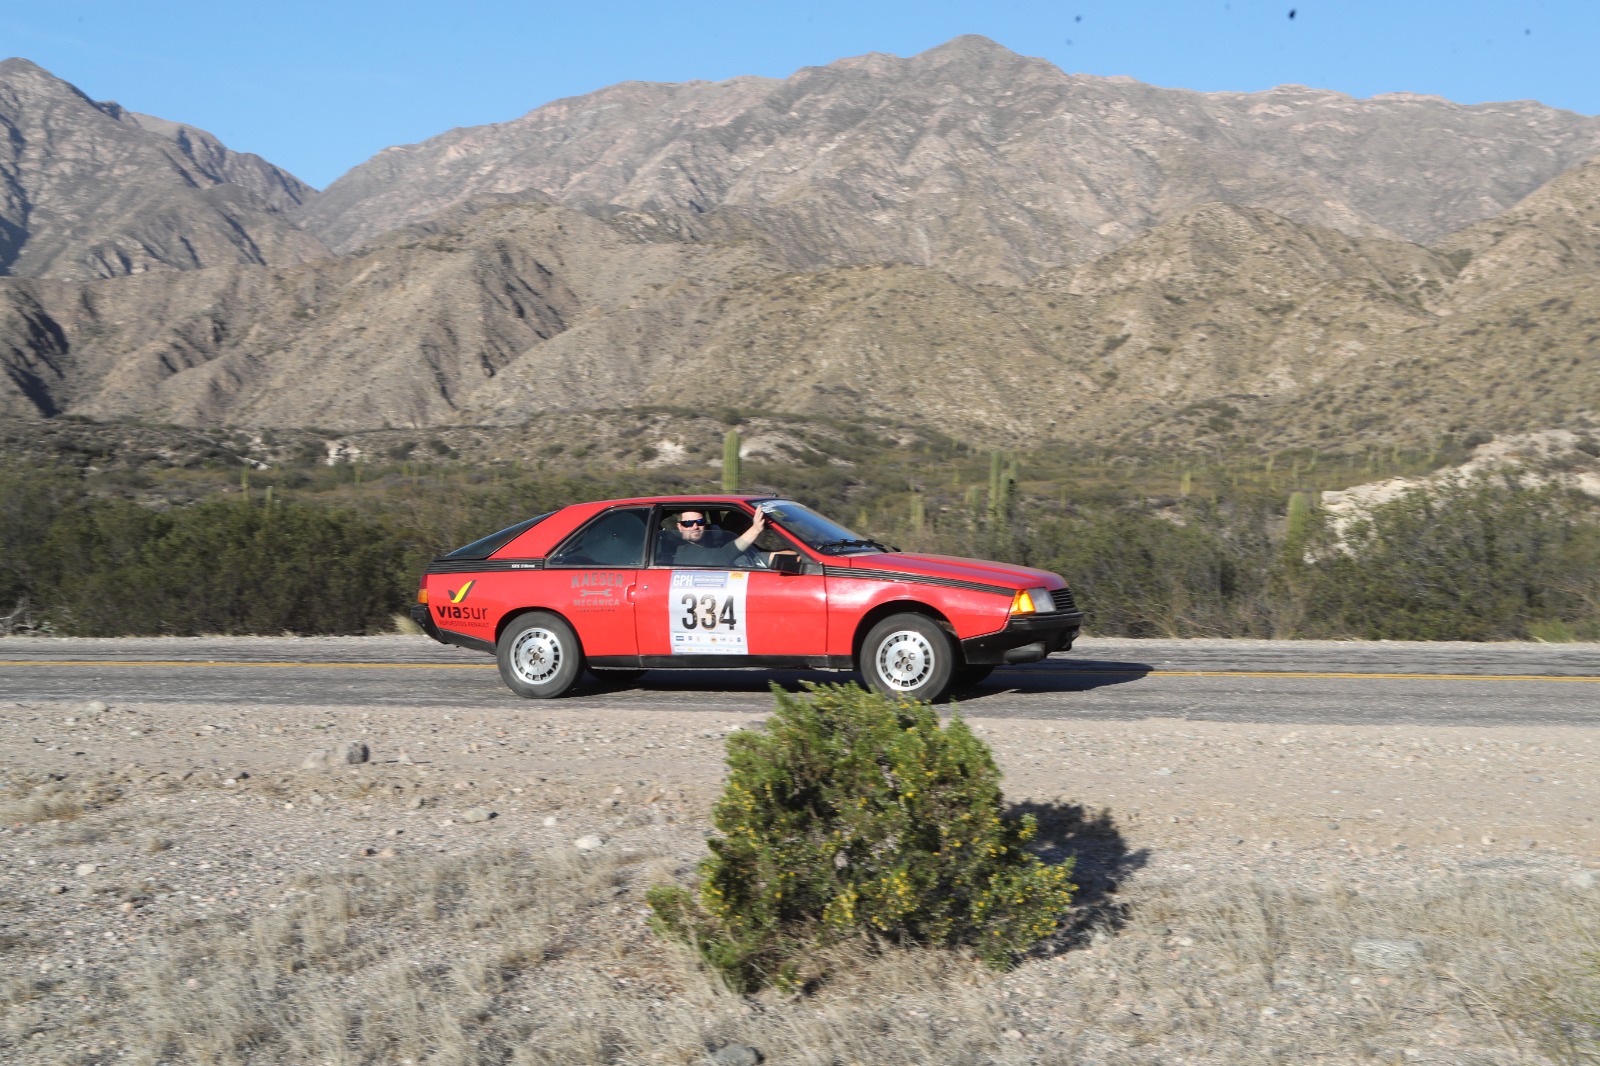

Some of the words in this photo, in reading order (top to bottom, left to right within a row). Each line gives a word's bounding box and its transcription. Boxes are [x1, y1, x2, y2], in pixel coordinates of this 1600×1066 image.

[571, 572, 624, 588] KAESER
[672, 575, 693, 587] GPH
[681, 593, 737, 630] 334
